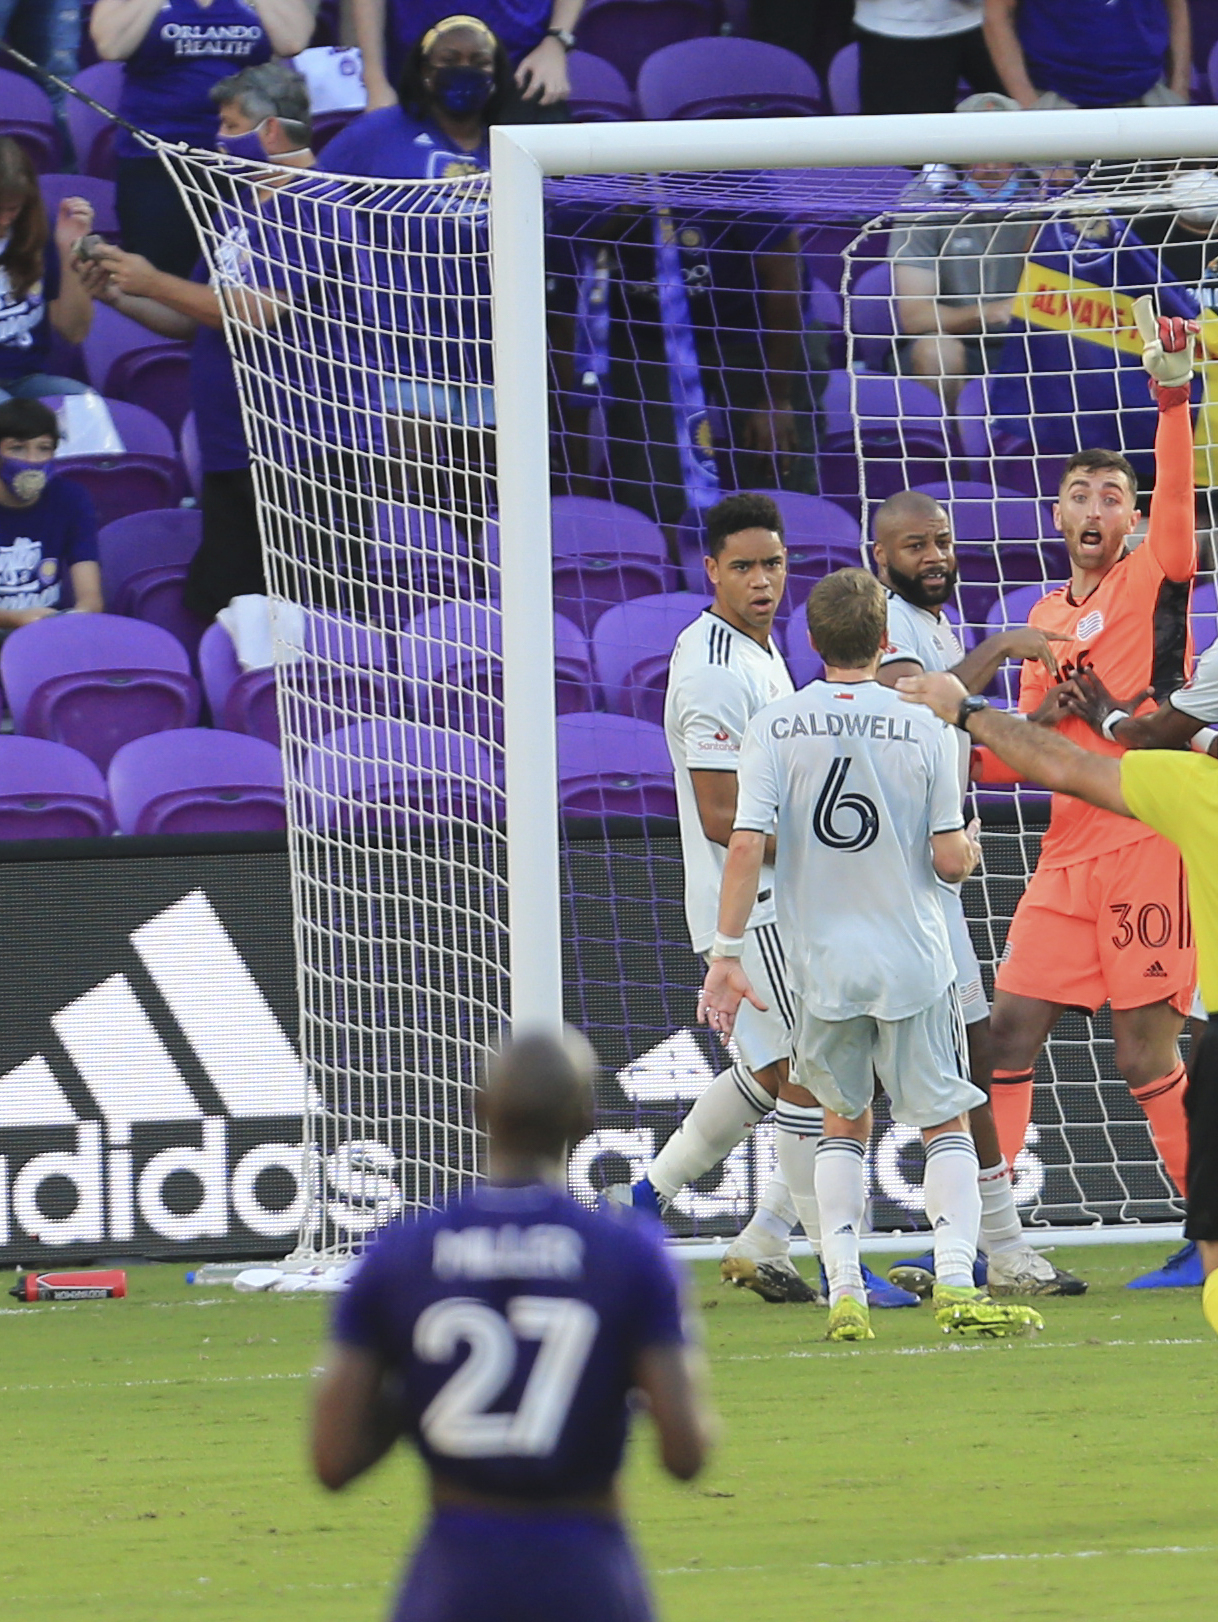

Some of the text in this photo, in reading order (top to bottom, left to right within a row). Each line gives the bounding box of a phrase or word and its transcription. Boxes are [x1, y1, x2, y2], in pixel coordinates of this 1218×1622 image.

[161, 23, 262, 39] ORLANDO
[174, 39, 253, 55] HEALTH
[1031, 283, 1125, 335] ALWAYS
[771, 712, 919, 743] CALDWELL
[813, 757, 880, 853] 6
[1110, 903, 1172, 950] 30
[0, 1114, 402, 1246] didas
[434, 1226, 584, 1279] MILLER
[413, 1297, 599, 1459] 27
